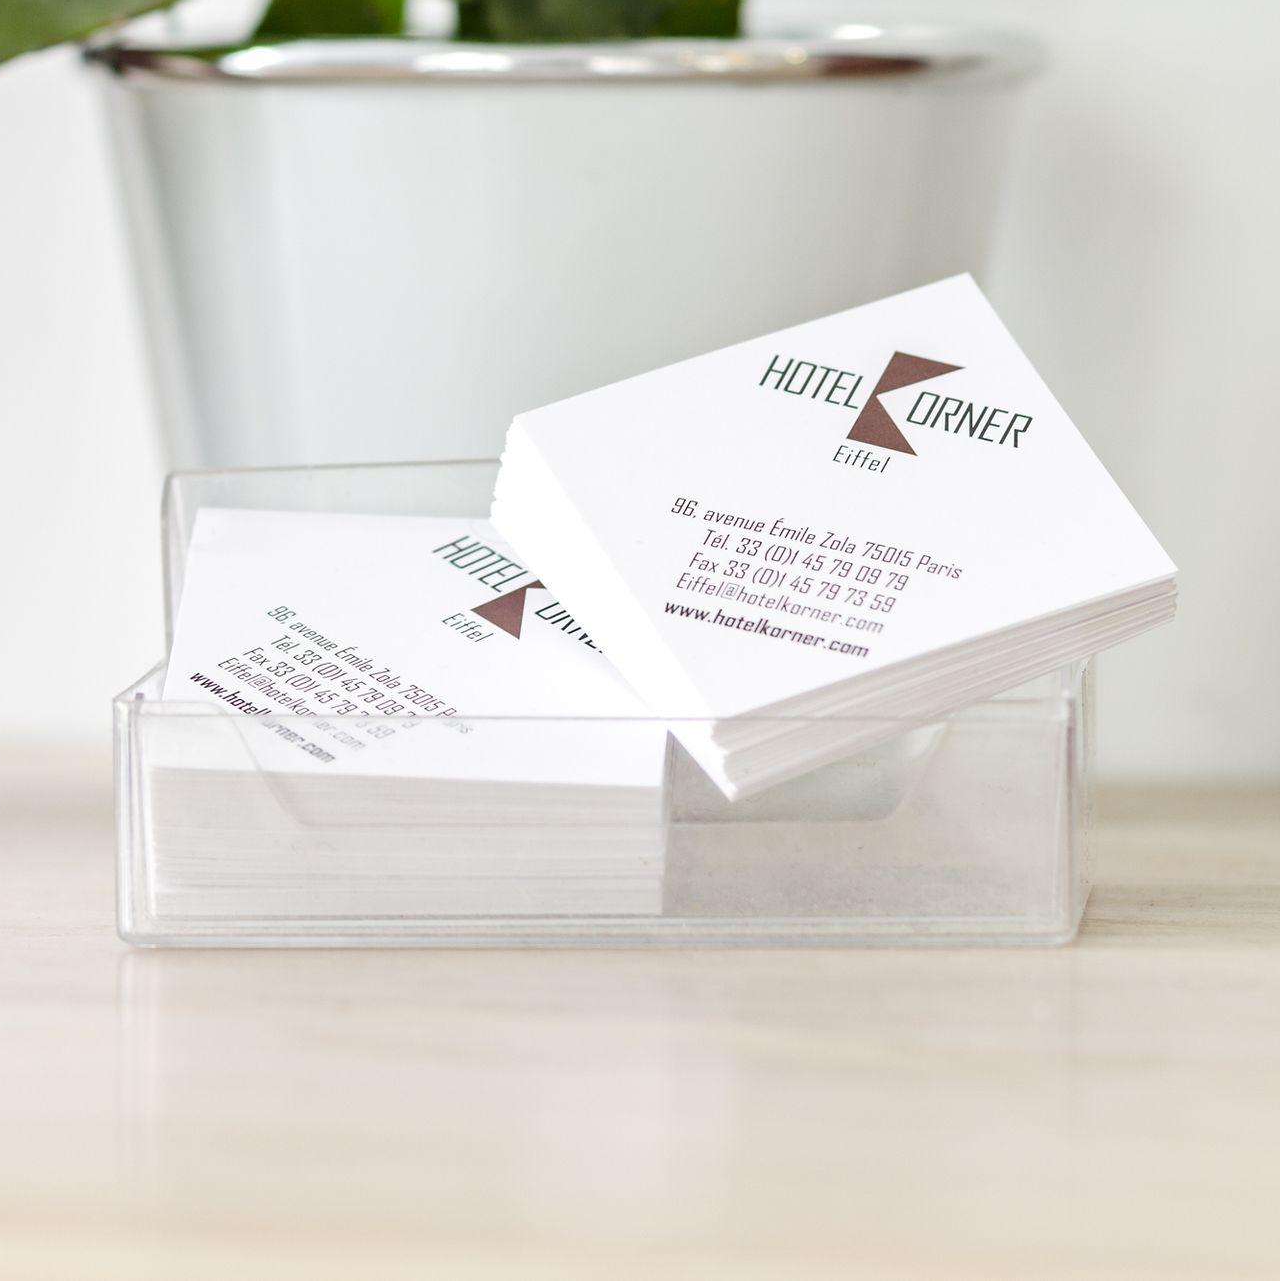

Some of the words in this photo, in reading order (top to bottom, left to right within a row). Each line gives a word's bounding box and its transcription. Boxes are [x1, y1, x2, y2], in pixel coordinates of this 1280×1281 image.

[759, 354, 864, 409] HOTEL
[833, 445, 891, 473] Eiffel
[432, 536, 528, 593] HOTEL
[702, 529, 728, 551] Tél.
[736, 537, 762, 557] 33
[764, 544, 799, 566] (0)1
[802, 552, 824, 572] 45
[831, 559, 853, 578] 79
[856, 566, 882, 585] 09
[887, 572, 909, 591] 79
[704, 509, 765, 533] avenue
[770, 518, 816, 545] Émile
[819, 531, 857, 555] Zola
[862, 541, 915, 567] 75015
[916, 555, 963, 579] Paris
[676, 572, 884, 634] Eiffel@hotelkorner.com
[689, 552, 719, 573] Fax
[723, 560, 750, 580] 33
[752, 567, 786, 588] (0)1
[790, 575, 811, 595] 45
[818, 581, 841, 601] 79
[845, 588, 868, 607] 73
[870, 594, 896, 614] 59
[442, 613, 494, 642] Eiffel
[665, 601, 869, 658] www.hotelkorner.com
[242, 647, 271, 666] Fax
[266, 662, 295, 678] 33
[314, 688, 340, 705] 45
[331, 700, 358, 716] 79
[271, 635, 296, 654] Tél.
[295, 649, 322, 666] 33
[341, 676, 366, 693] 45
[358, 688, 382, 704] 79
[378, 699, 404, 716] 09
[289, 620, 338, 651] avenue
[334, 646, 372, 674] Émile
[369, 668, 400, 689] Zola
[399, 684, 445, 712] 75015
